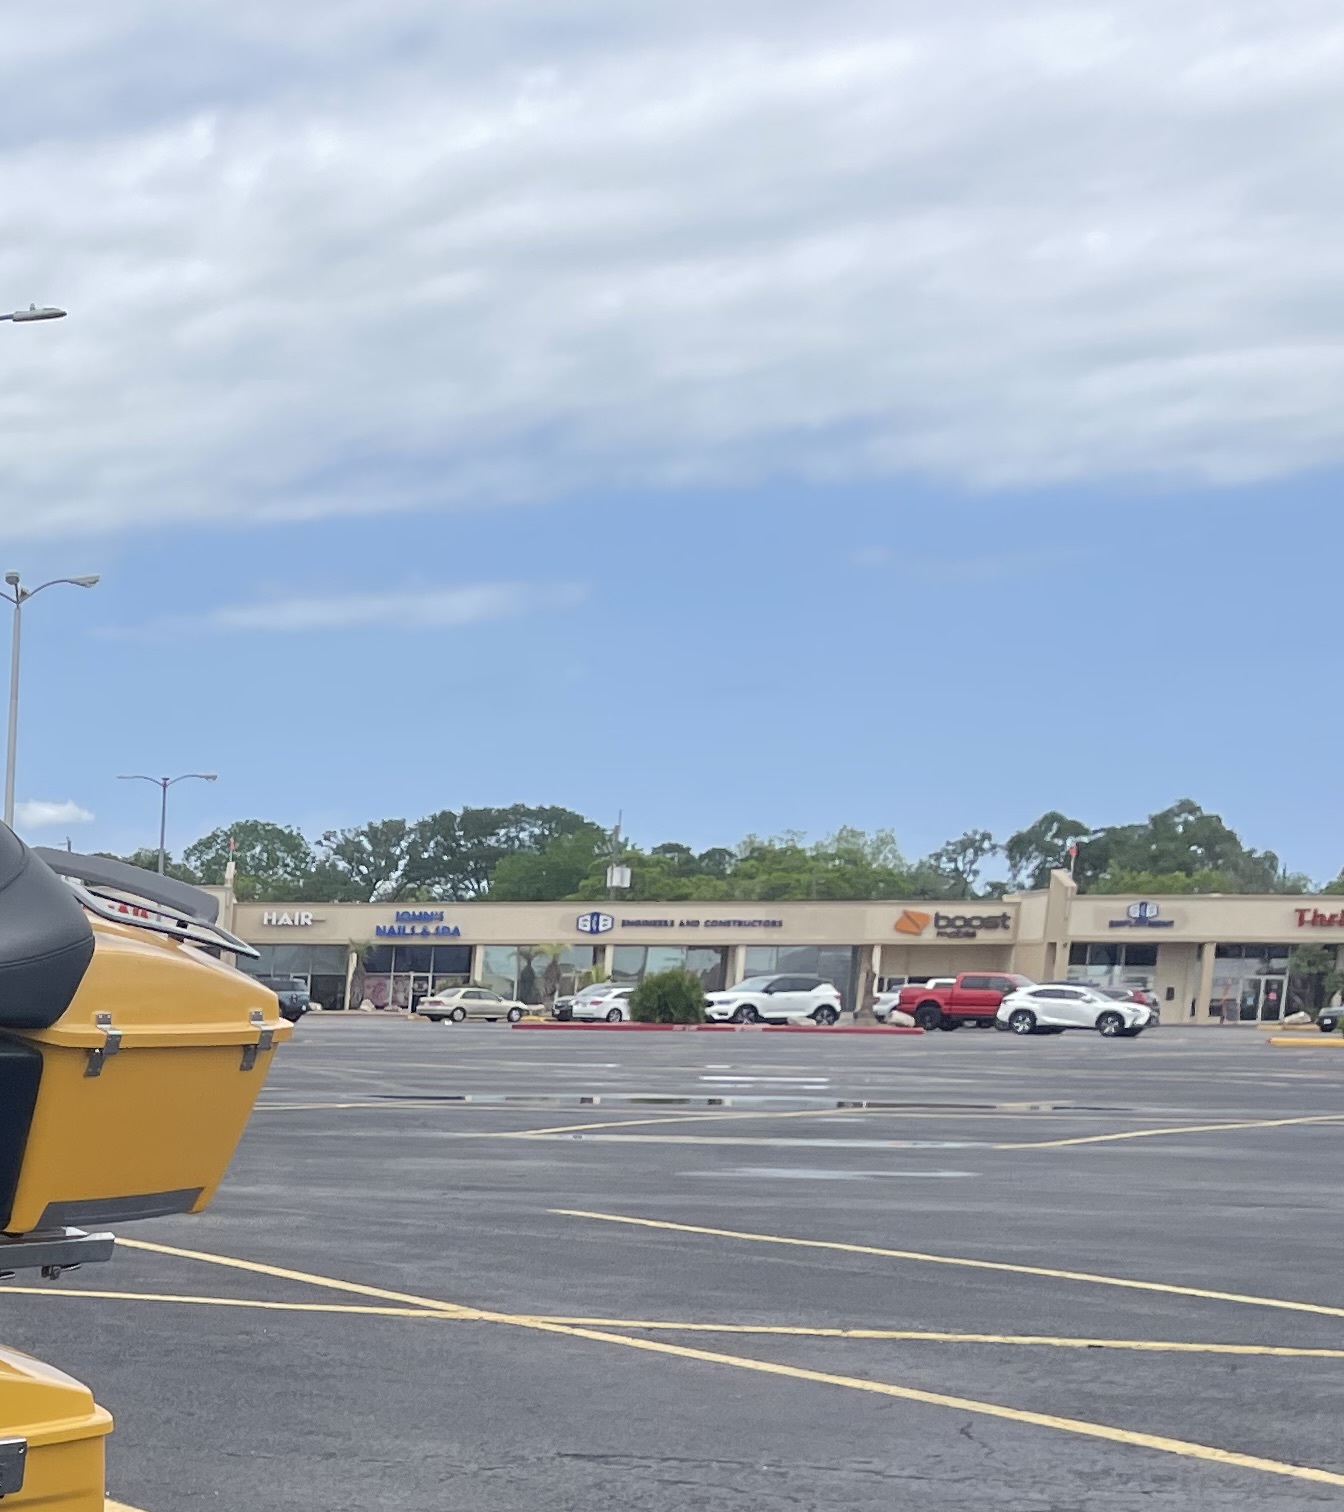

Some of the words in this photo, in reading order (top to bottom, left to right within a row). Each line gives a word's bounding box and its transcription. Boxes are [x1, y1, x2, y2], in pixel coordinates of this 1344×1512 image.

[263, 911, 313, 926] HAIR
[679, 919, 700, 927] AND
[934, 912, 1010, 930] boost
[376, 925, 416, 936] NAILS
[420, 925, 430, 936] &
[435, 925, 461, 936] SPA
